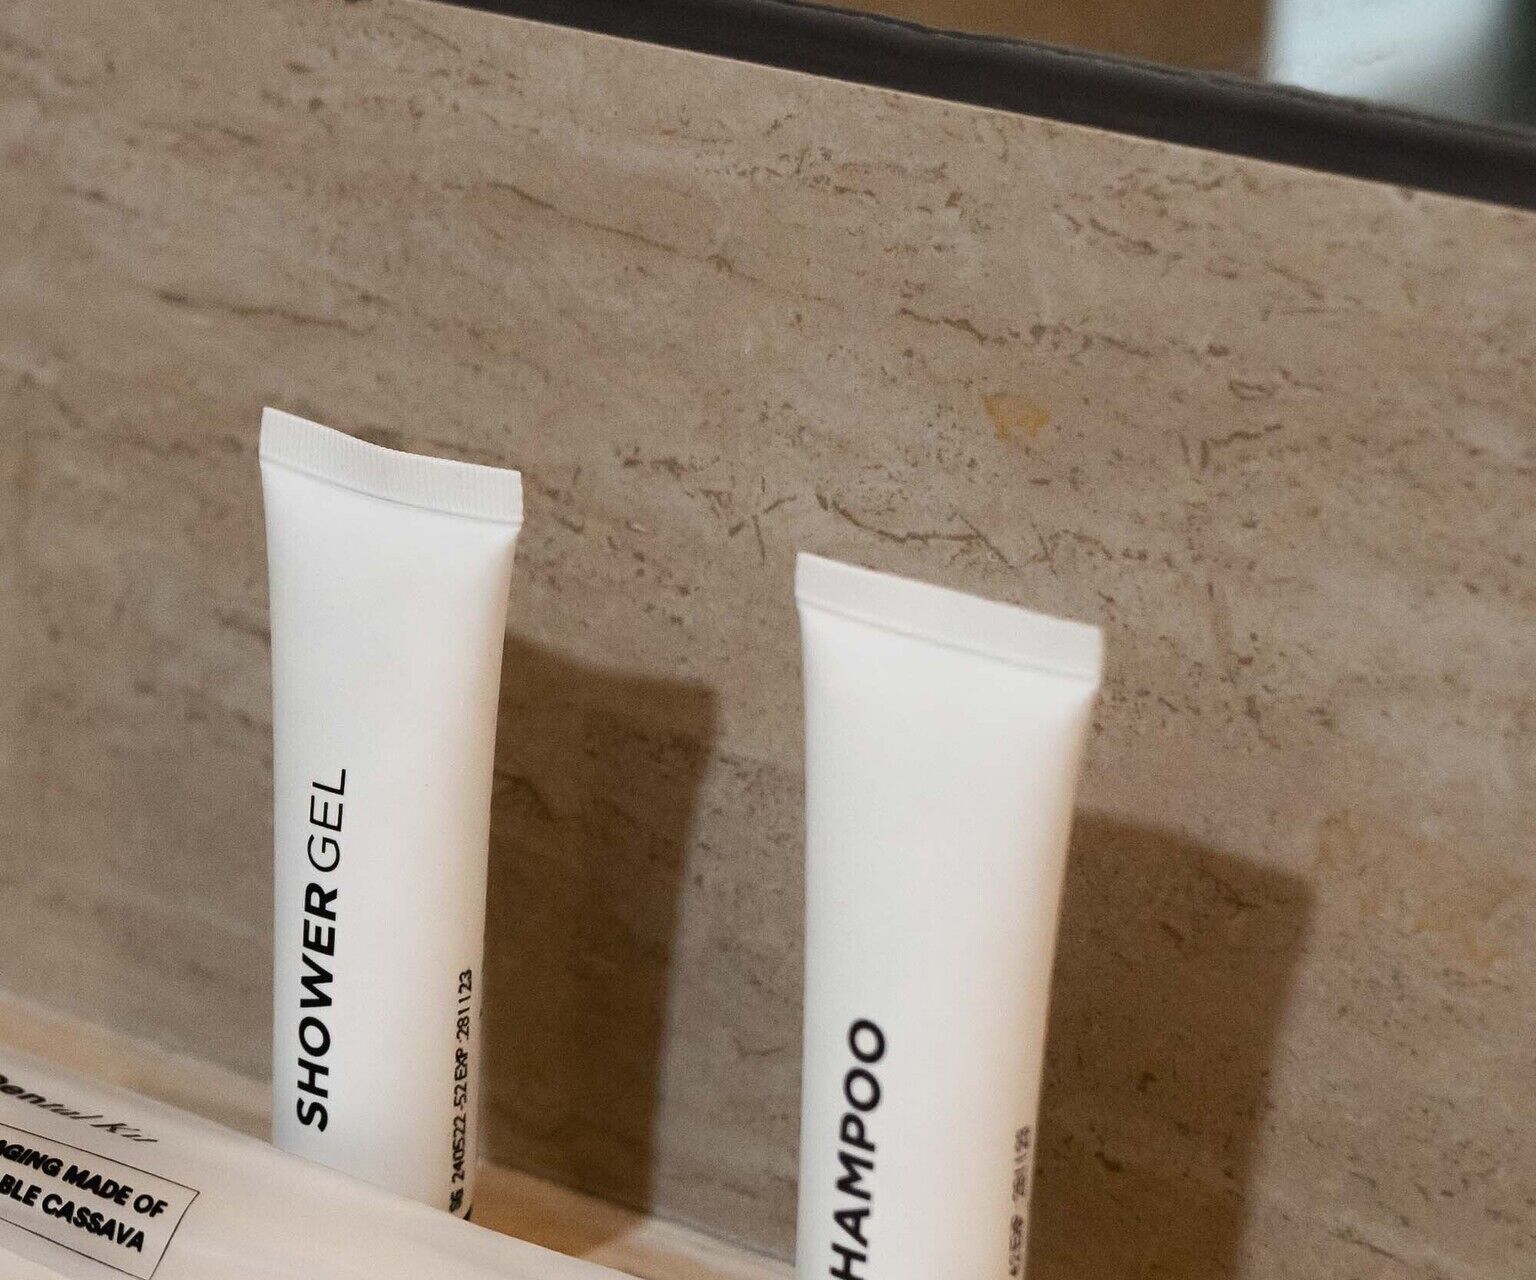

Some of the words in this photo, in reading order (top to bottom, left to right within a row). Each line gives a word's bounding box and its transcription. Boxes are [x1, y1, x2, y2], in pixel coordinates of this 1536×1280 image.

[306, 767, 347, 874] GEL
[296, 881, 338, 1133] SHOWER
[40, 1193, 147, 1253] CASSAVA
[62, 1164, 134, 1207] MADE
[132, 1193, 169, 1219] OF
